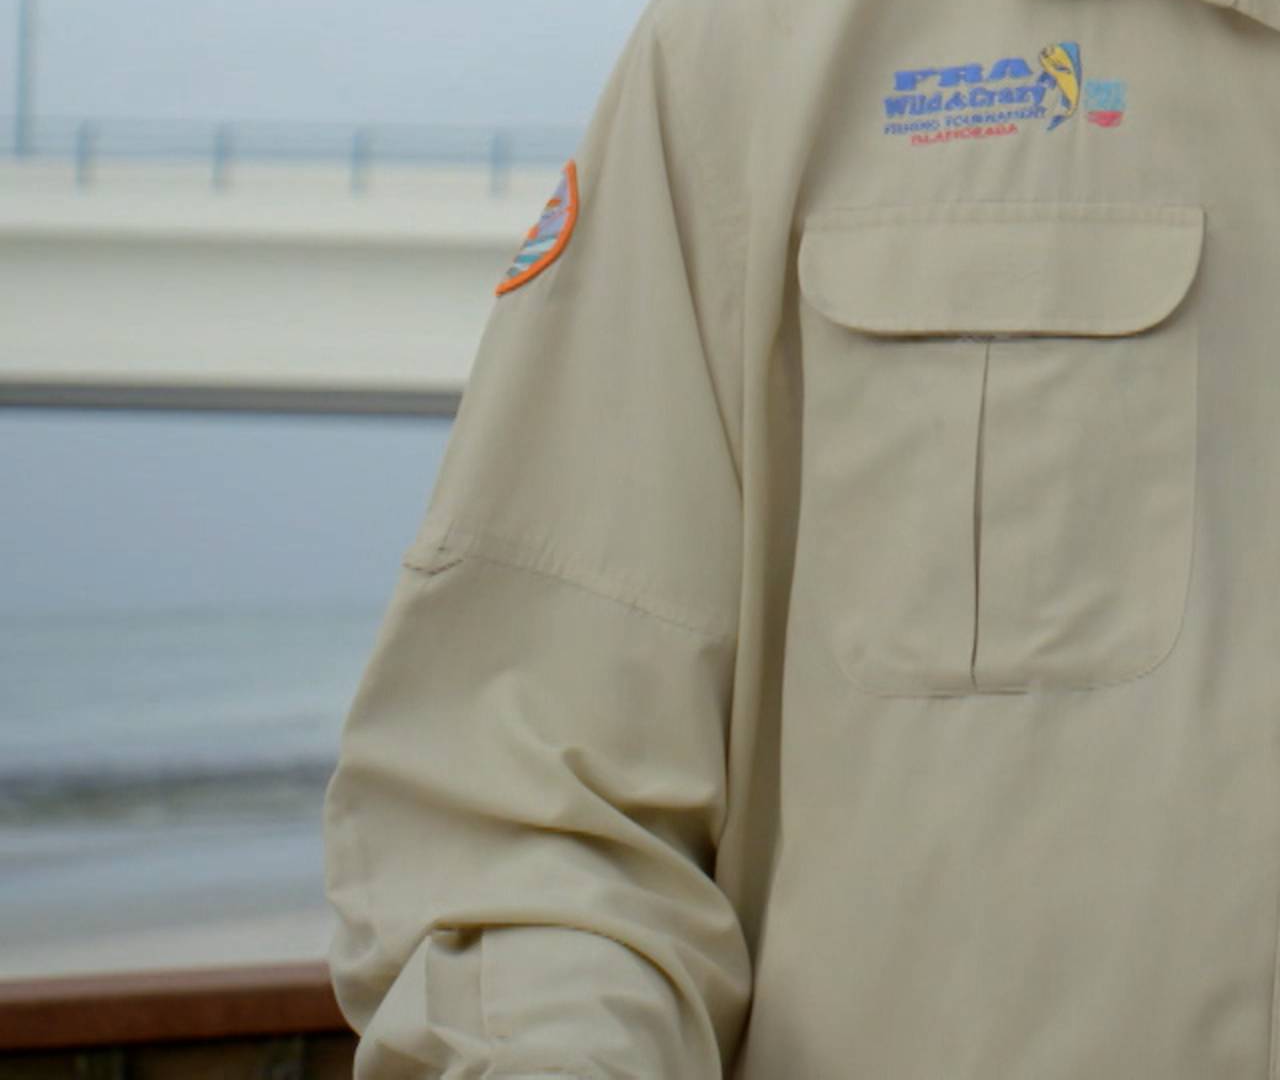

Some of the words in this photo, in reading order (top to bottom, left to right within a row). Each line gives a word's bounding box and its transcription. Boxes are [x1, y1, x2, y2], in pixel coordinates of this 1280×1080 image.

[894, 58, 1032, 90] FRA
[884, 119, 941, 136] FISHING
[946, 106, 1048, 128] TOURNAMENT
